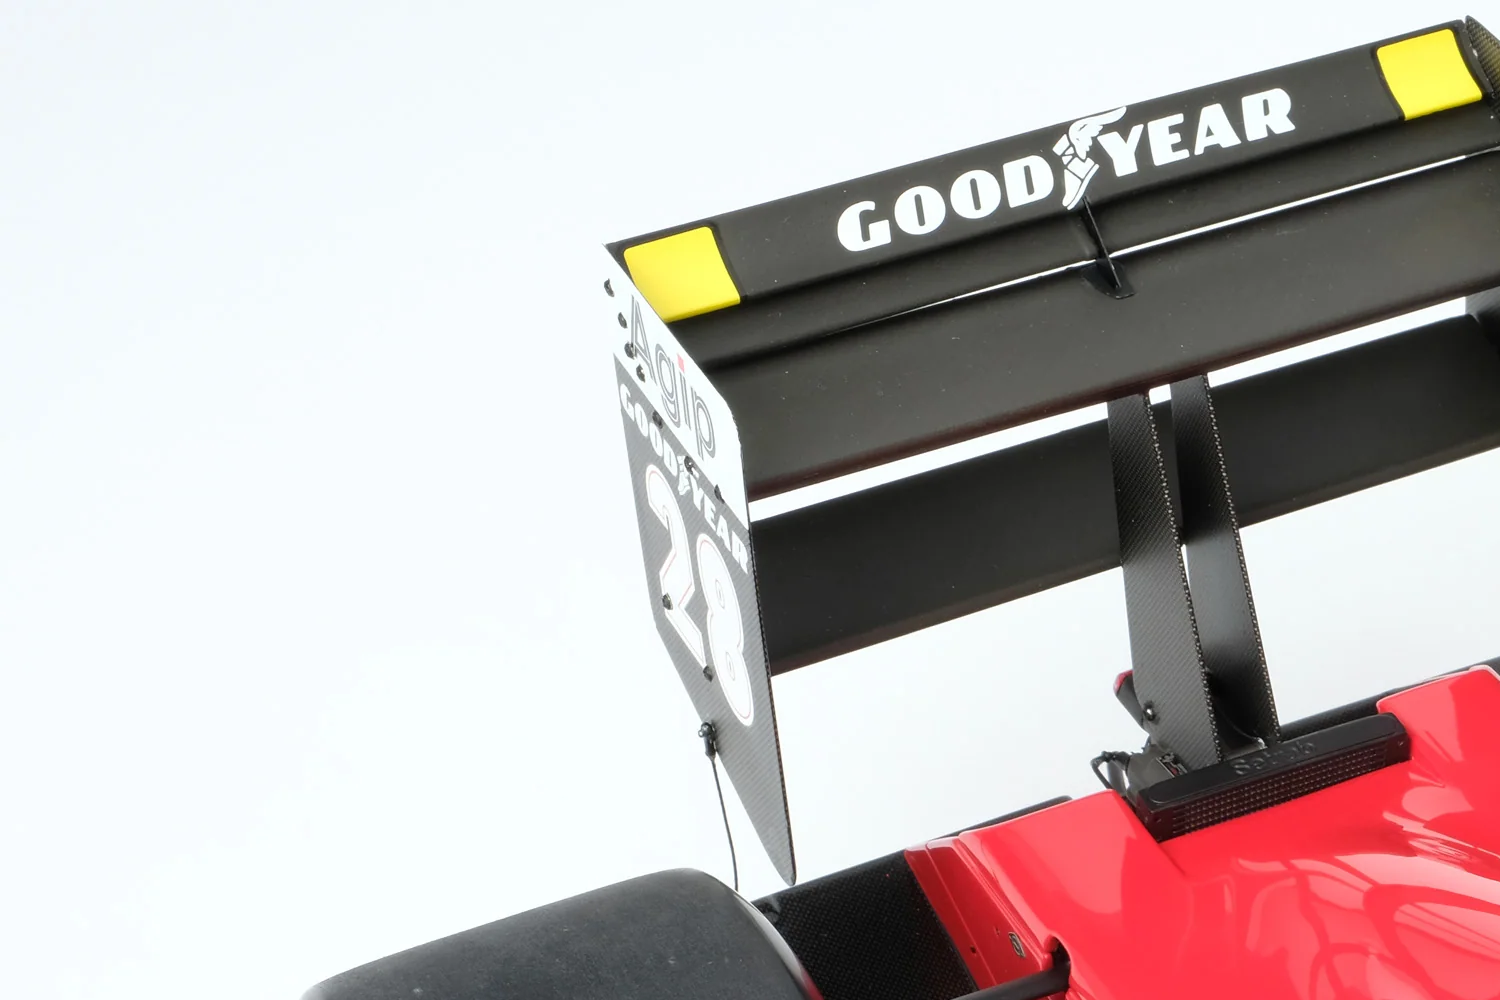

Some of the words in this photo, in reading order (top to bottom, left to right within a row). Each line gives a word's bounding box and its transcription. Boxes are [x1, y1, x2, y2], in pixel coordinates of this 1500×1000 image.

[837, 87, 1296, 252] GOODYEAR
[630, 294, 717, 461] Agip
[619, 382, 748, 575] GOODYEAR
[646, 464, 755, 727] 28
